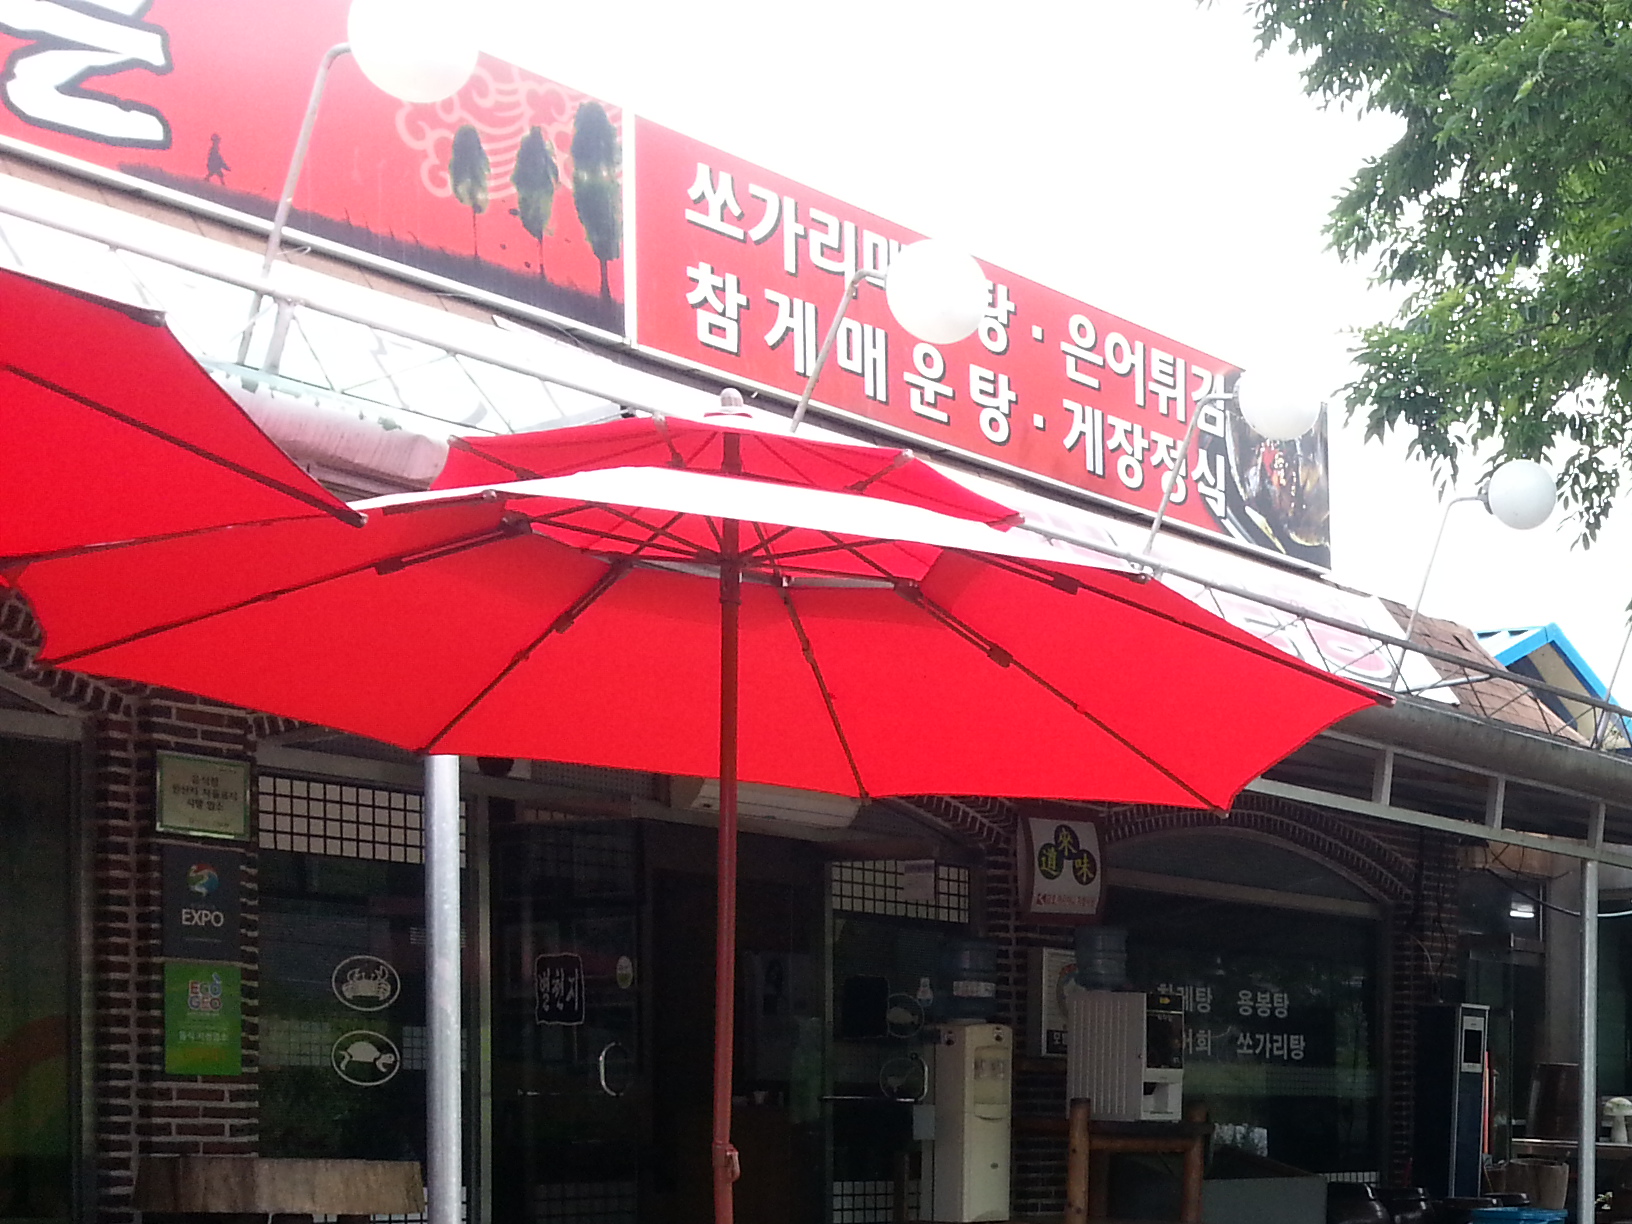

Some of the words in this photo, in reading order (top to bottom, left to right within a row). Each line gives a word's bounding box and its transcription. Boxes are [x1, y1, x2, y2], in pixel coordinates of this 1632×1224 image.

[686, 260, 1017, 445] 참게매운탕
[1063, 399, 1227, 517] 게장정식
[1060, 314, 1226, 438] 은어튀김
[181, 908, 225, 928] EXPO
[188, 977, 223, 998] ECO
[537, 967, 579, 1013] 별천지
[187, 994, 223, 1012] GEO
[1235, 989, 1291, 1019] 용봉탕
[1235, 1031, 1307, 1061] 쏘가리탕
